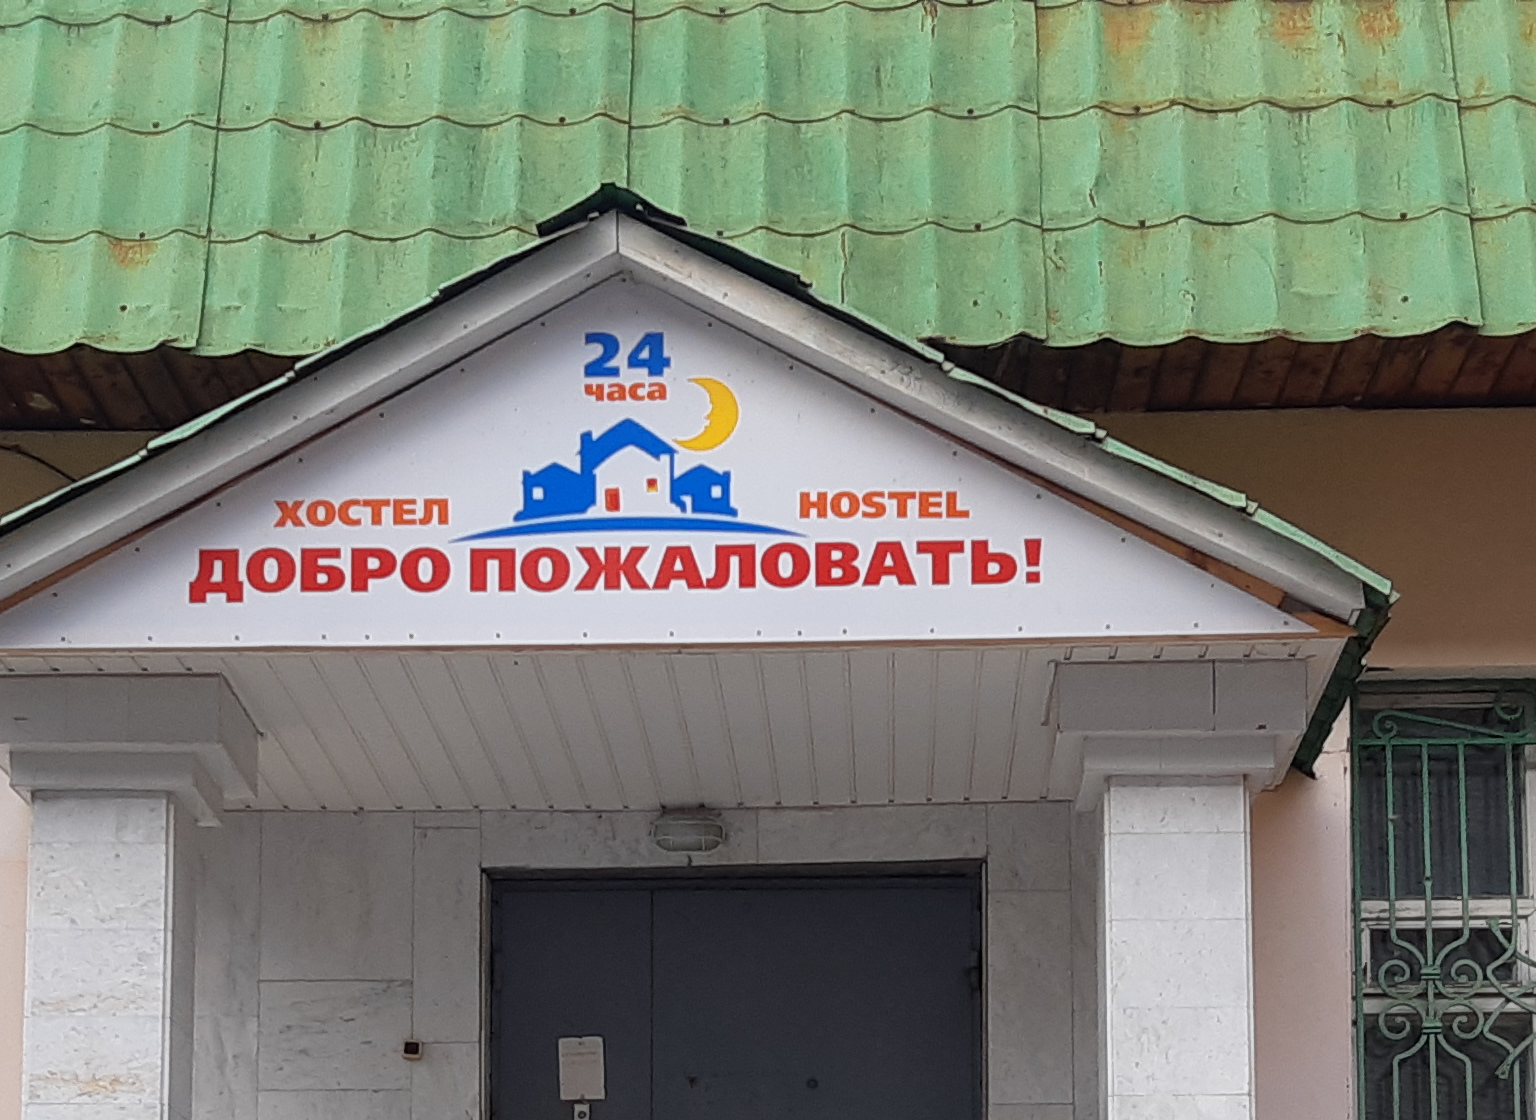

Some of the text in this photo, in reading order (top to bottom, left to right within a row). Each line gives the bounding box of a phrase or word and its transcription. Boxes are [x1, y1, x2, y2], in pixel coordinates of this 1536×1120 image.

[583, 331, 672, 378] 24
[583, 382, 668, 402] часа
[273, 497, 450, 528] ХОСТЕЛ
[798, 490, 971, 520] HOSTEL
[188, 538, 1043, 604] ДОБРО ПОЖАЛОВАТЬ!
